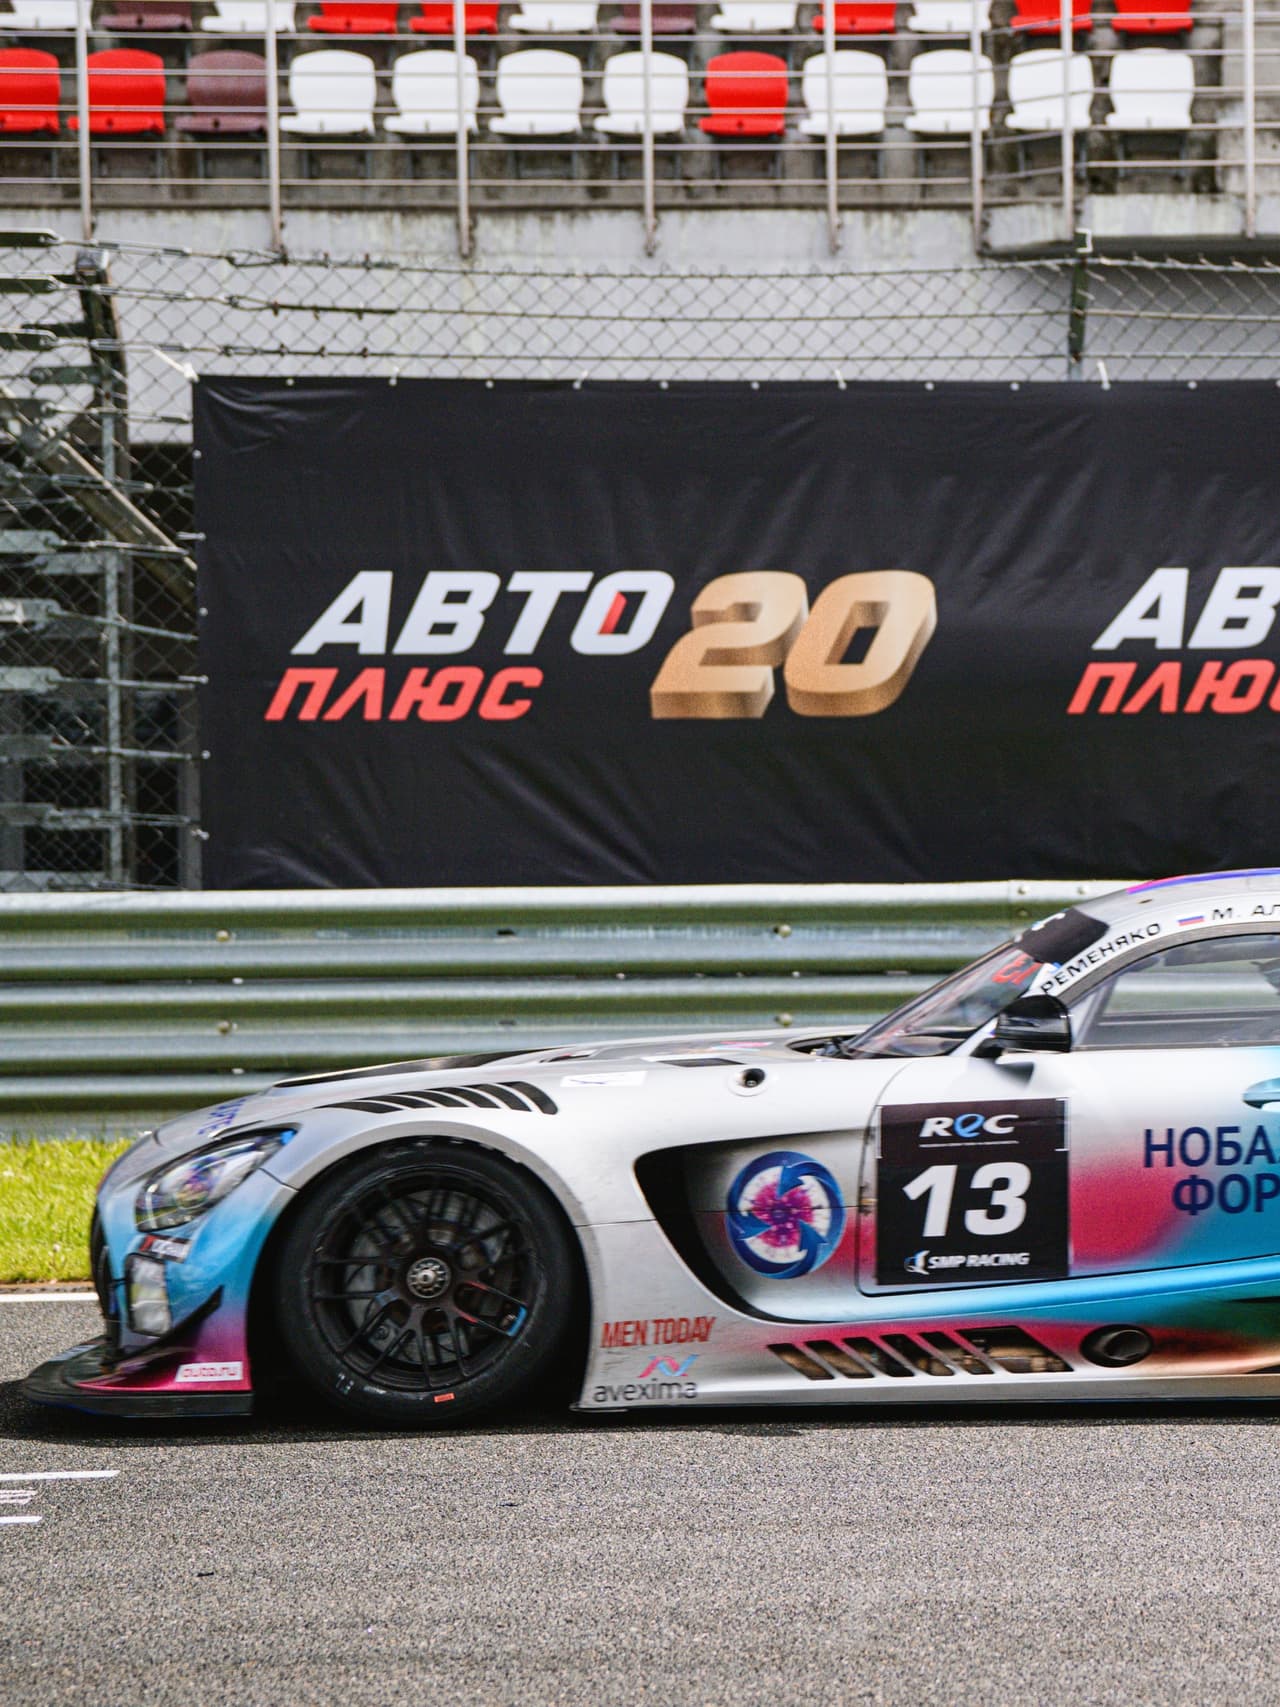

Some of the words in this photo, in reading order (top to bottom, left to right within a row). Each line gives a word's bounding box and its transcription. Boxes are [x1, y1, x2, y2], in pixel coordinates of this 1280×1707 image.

[291, 570, 675, 655] АВТО
[650, 570, 938, 720] 20
[264, 667, 544, 722] ПЛЮС
[902, 1161, 1031, 1237] 13
[927, 1255, 966, 1269] SMP
[966, 1252, 1031, 1268] RACING
[600, 1320, 648, 1348] MEN
[653, 1316, 717, 1344] TODAY
[592, 1378, 698, 1402] avexima
